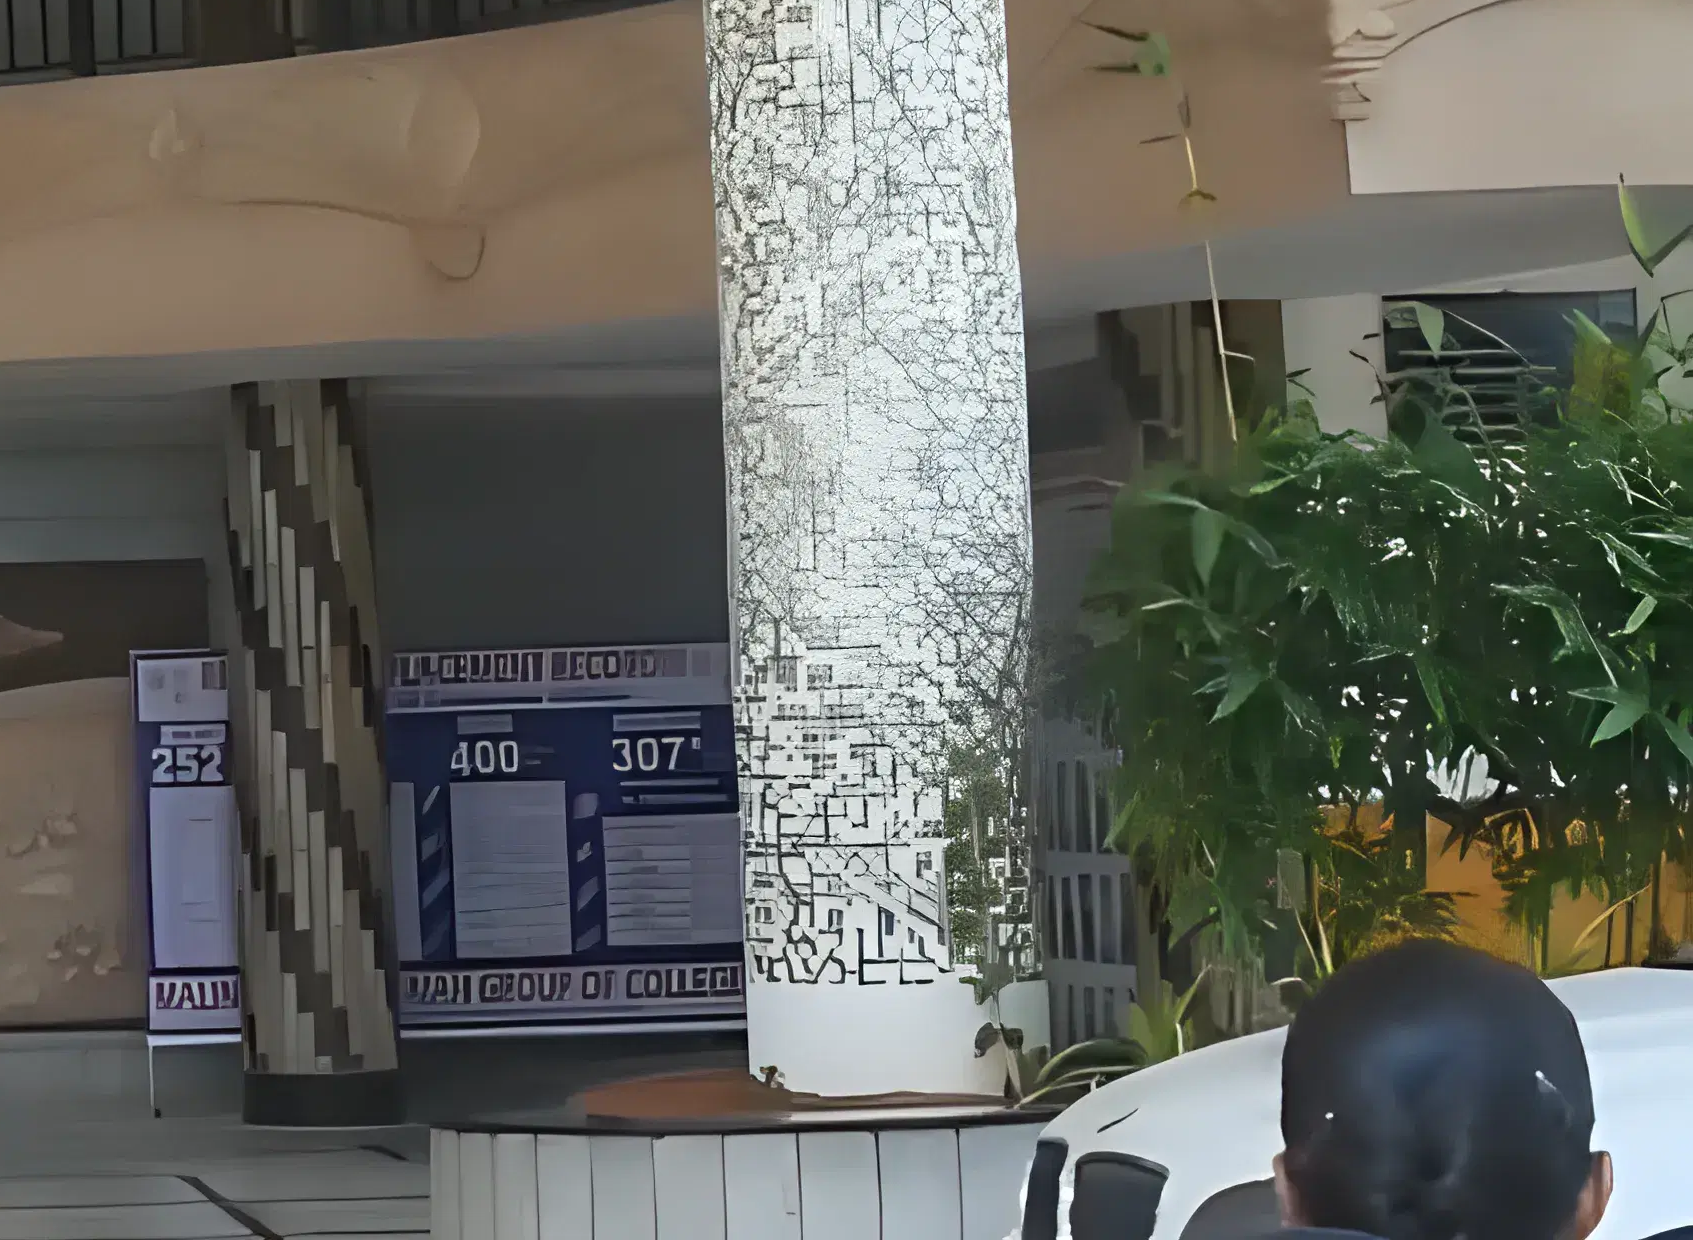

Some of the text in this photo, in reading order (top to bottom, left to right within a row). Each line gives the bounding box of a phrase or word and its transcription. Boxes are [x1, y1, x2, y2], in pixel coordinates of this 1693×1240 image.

[151, 744, 224, 783] 252
[450, 740, 519, 776] 400
[478, 971, 571, 1003] GROUP
